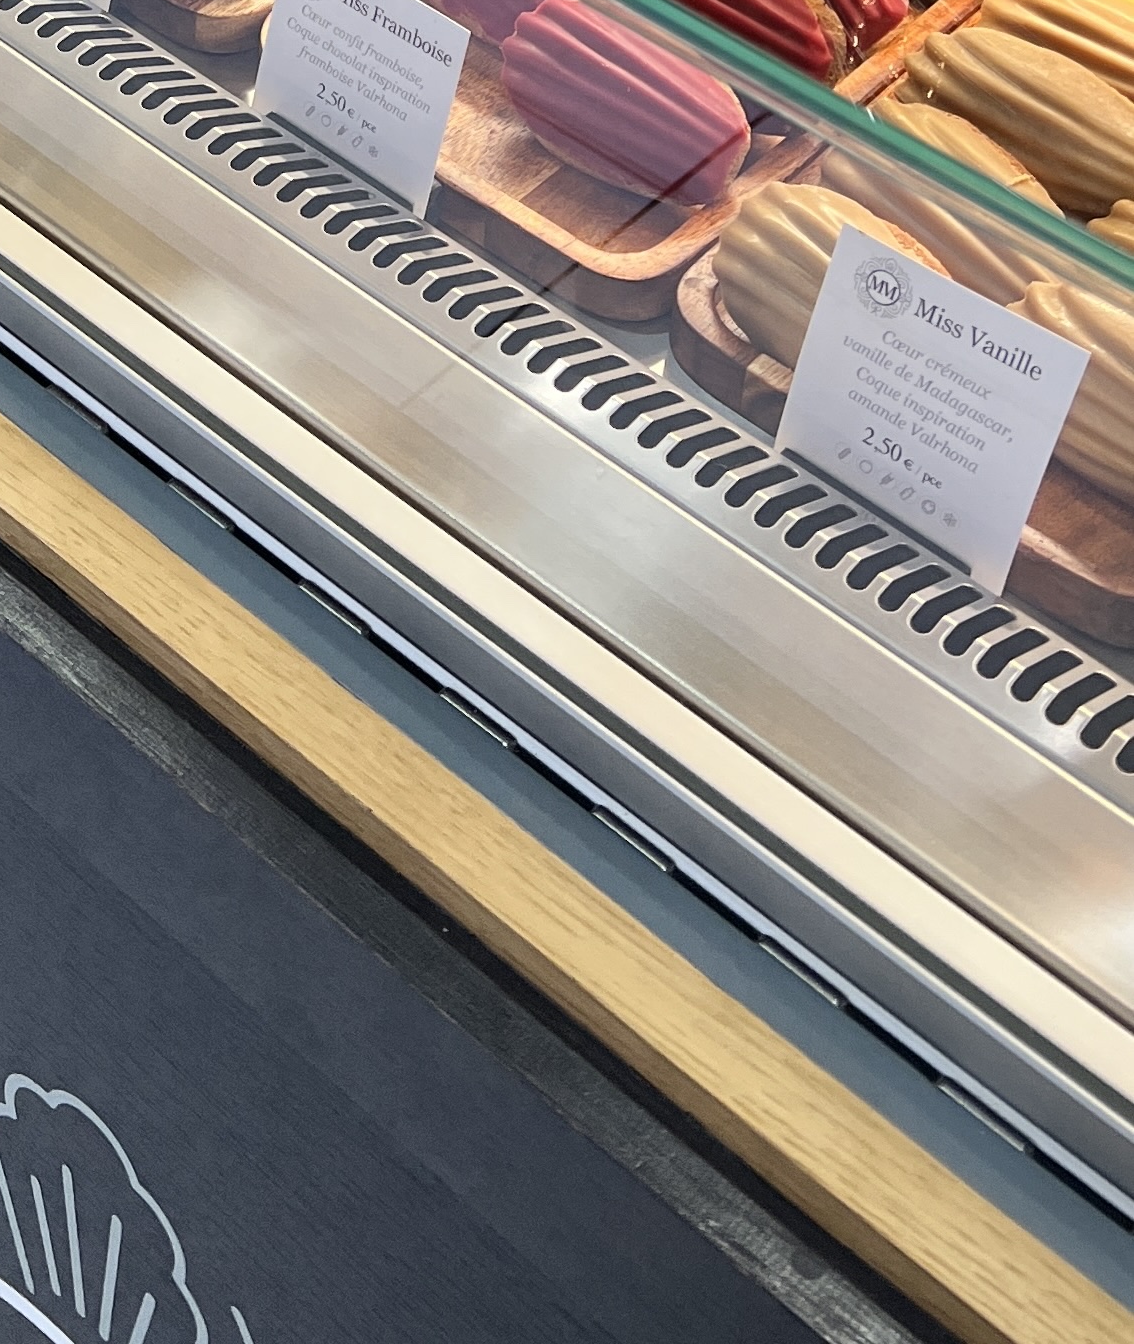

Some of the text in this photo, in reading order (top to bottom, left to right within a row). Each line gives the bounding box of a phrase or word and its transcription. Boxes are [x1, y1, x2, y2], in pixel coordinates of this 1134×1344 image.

[286, 16, 430, 114] Coque chocolat inspiration
[301, 4, 423, 90] Cœur confit framboise,
[370, 5, 452, 67] Framboise
[295, 45, 407, 121] framboise Valrhona
[316, 82, 346, 111] 2,50
[347, 108, 355, 119] €
[360, 119, 376, 133] pce
[867, 275, 898, 300] MM
[881, 330, 992, 400] Cœur crémeux
[913, 297, 1041, 380] Miss Vanille
[843, 335, 1012, 443] vanille de Madagascar,
[856, 366, 985, 451] Coque inspiration
[847, 389, 978, 474] amande Valrhona
[861, 426, 902, 461] 2,50
[903, 458, 914, 471] €
[921, 472, 942, 489] pce
